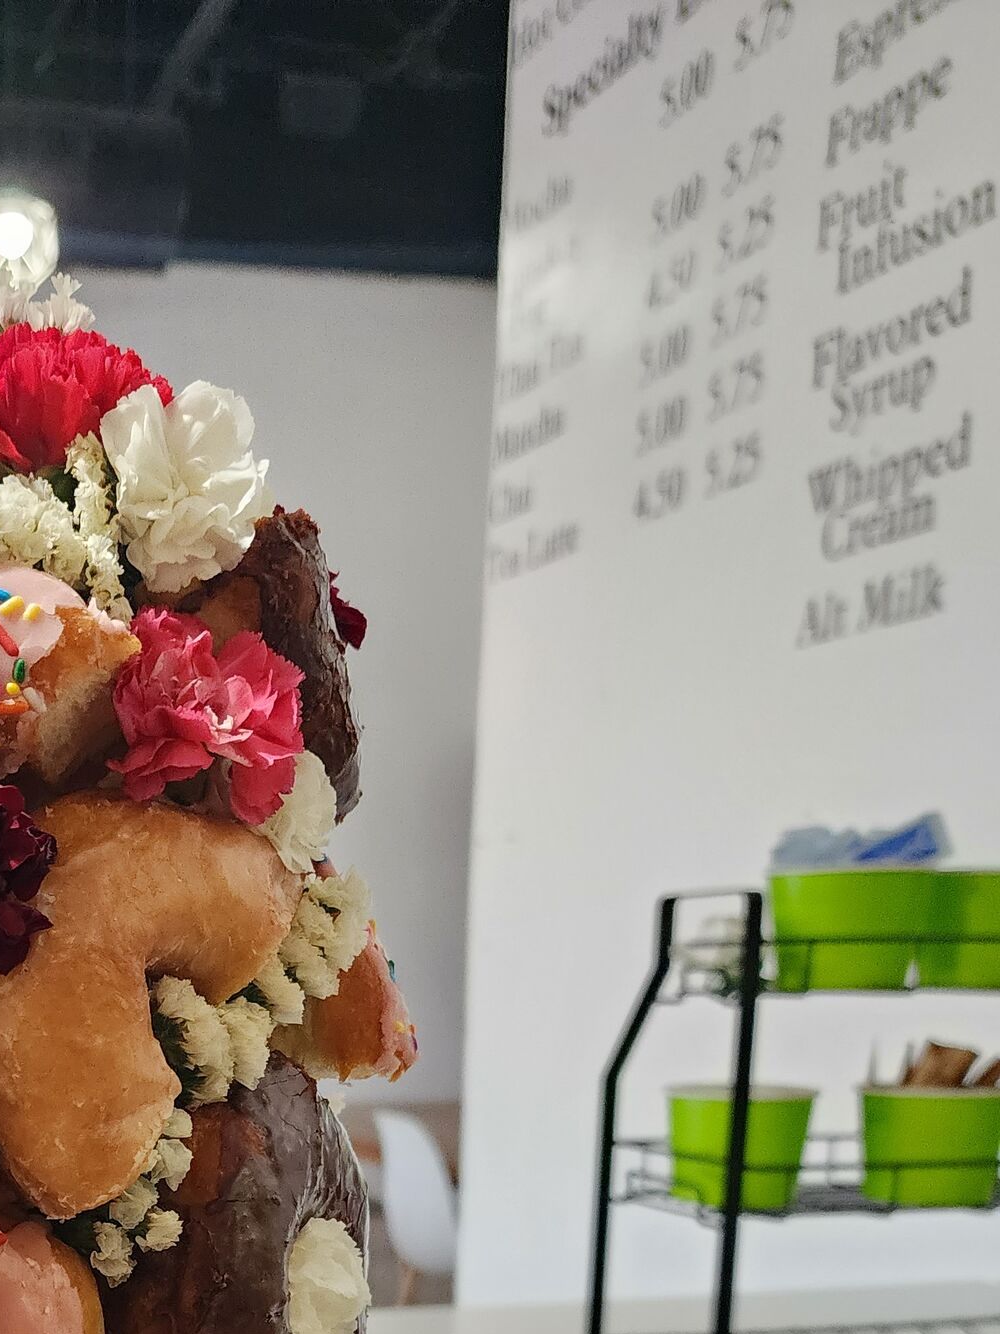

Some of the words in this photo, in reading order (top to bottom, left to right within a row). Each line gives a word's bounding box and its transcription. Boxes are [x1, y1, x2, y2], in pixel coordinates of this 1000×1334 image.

[543, 3, 666, 136] Specialty
[825, 55, 953, 168] Frappe
[818, 160, 907, 252] Fruit
[838, 178, 996, 294] Infusion
[813, 264, 973, 390] Flavored
[828, 355, 937, 437] Syrup
[808, 409, 973, 514] Whipped
[820, 494, 937, 564] Cream
[858, 562, 947, 634] Milk
